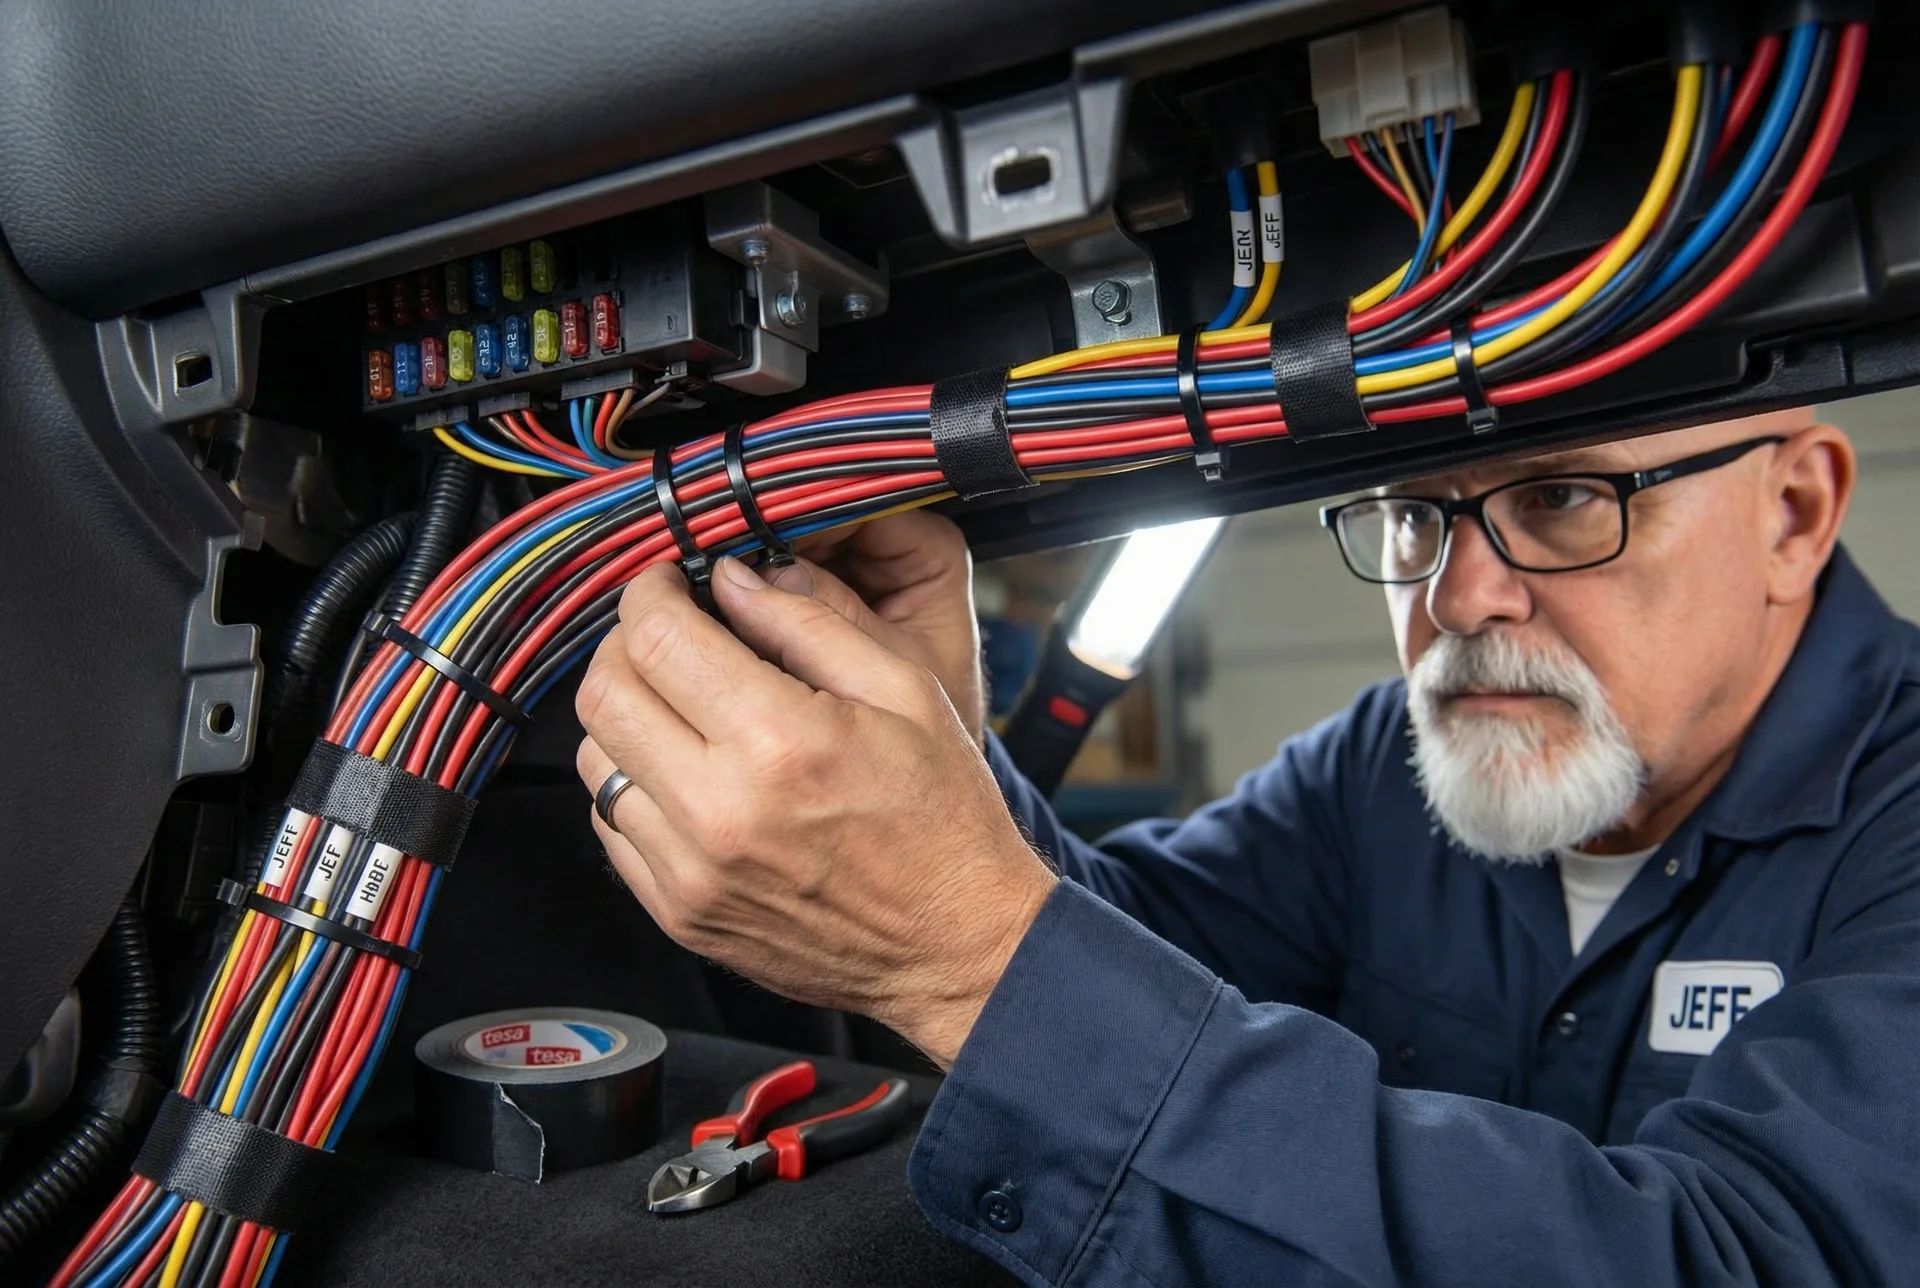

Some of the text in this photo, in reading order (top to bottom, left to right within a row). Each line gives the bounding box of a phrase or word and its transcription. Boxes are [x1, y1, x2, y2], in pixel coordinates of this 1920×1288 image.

[1265, 213, 1281, 248] JEFF
[273, 824, 298, 869] JEFF
[318, 843, 341, 880] JEF
[484, 1027, 524, 1046] tesa
[532, 1048, 576, 1063] tesa
